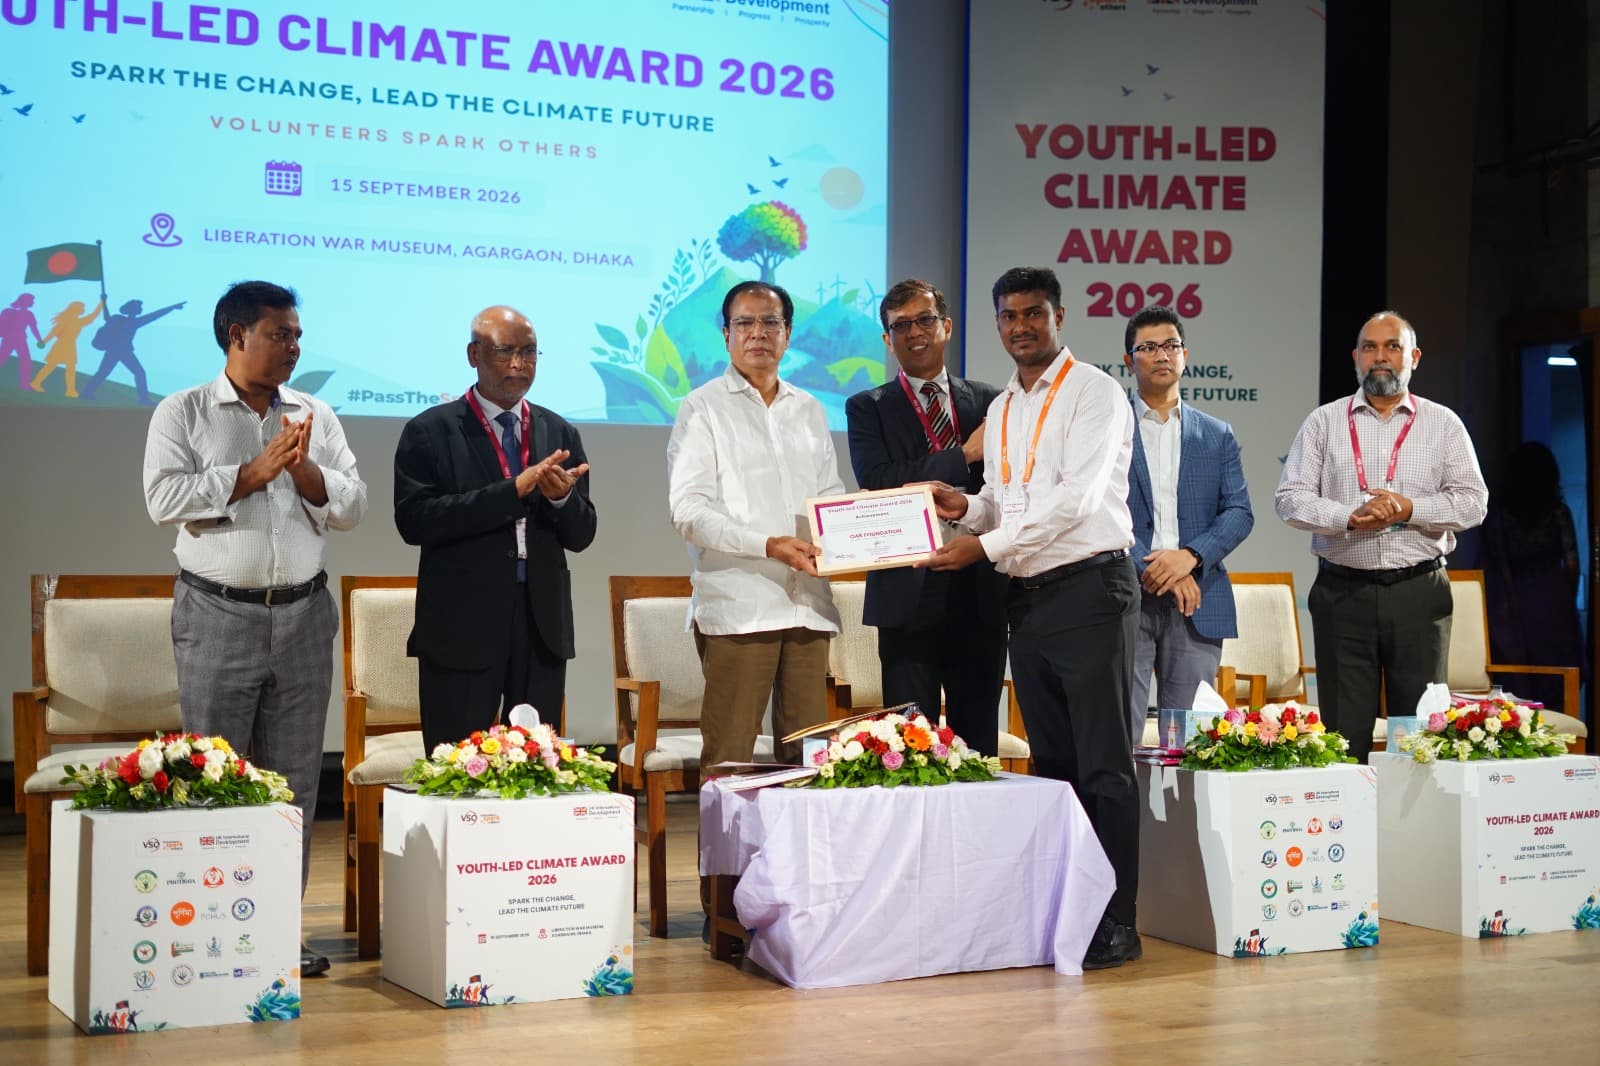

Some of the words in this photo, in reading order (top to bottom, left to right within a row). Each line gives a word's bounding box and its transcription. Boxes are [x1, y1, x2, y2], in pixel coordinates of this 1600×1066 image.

[278, 13, 510, 71] CLIMATE
[527, 39, 703, 88] AWARD
[719, 58, 835, 101] 2026
[71, 60, 167, 86] SPARK
[173, 69, 228, 90] THE
[236, 75, 362, 105] CHANGE,
[372, 87, 439, 109] LEAD
[445, 93, 495, 114] THE
[502, 99, 614, 124] CLIMATE
[622, 109, 715, 133] FUTURE
[209, 114, 389, 143] VOLUNTEERS
[401, 130, 485, 151] SPARK
[498, 139, 598, 159] OTHERS
[1015, 124, 1277, 162] YOUTH-LED
[331, 178, 353, 192] 15
[359, 180, 471, 201] SEPTEMBER
[477, 188, 521, 205] 2026
[1044, 173, 1247, 211] CLIMATE
[204, 228, 316, 248] LIBERATION
[322, 236, 365, 251] WAR
[371, 238, 457, 259] MUSEUM,
[462, 244, 568, 266] AGARGAON,
[573, 251, 635, 267] DHAKA
[1057, 229, 1232, 265] AWARD
[1086, 282, 1203, 319] 2026
[1181, 365, 1232, 380] ANGE,
[1193, 388, 1258, 401] FUTURE
[1486, 814, 1531, 825] YOUTH-LED
[1533, 811, 1567, 823] CLIMATE
[1570, 809, 1600, 820] AWARD
[1534, 826, 1554, 836] 2026
[457, 861, 523, 875] YOUTH-LED
[527, 856, 577, 871] CLIMATE
[581, 854, 626, 867] AWARD
[528, 874, 557, 886] 2026
[498, 908, 515, 916] LEAD
[516, 906, 529, 914] THE
[530, 905, 559, 913] CLIMATE
[560, 902, 585, 910] FUTURE
[508, 897, 530, 905] SPARK
